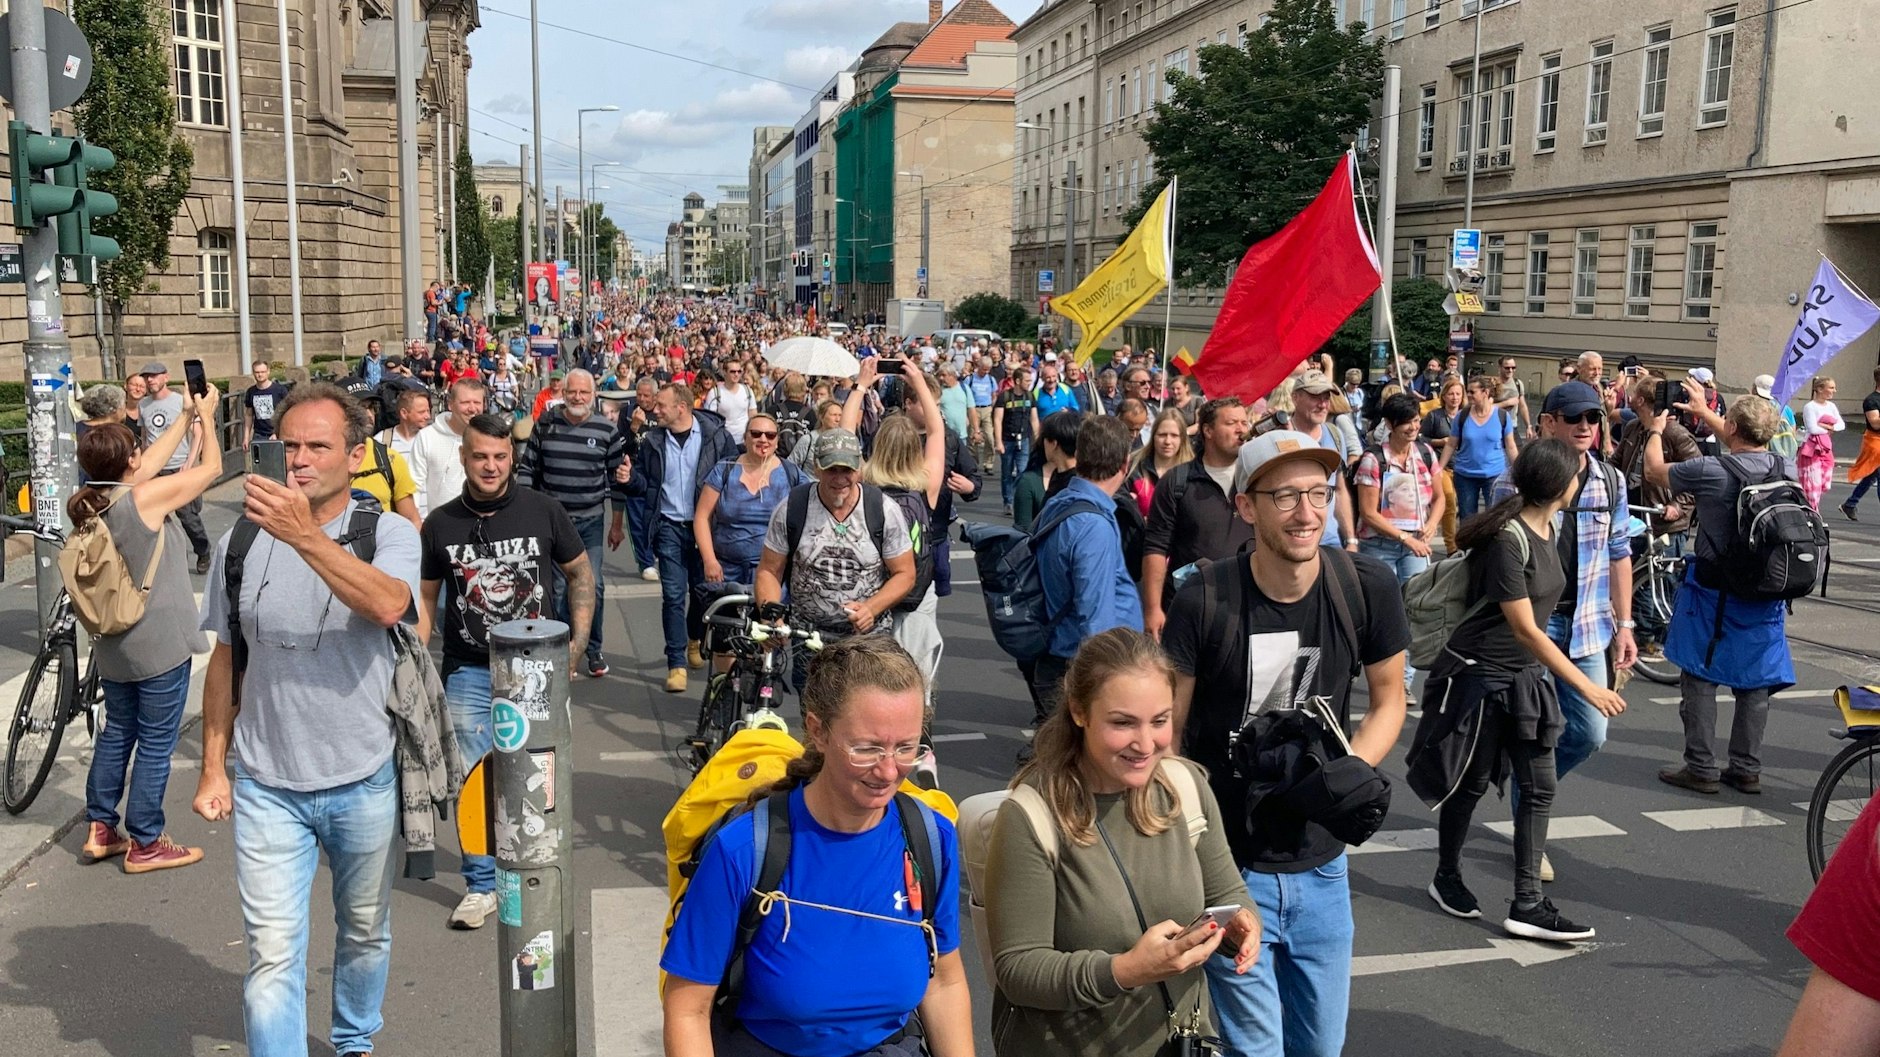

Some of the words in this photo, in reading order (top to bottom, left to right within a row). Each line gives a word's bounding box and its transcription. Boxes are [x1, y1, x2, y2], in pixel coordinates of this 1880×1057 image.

[1458, 294, 1480, 306] Ja!
[38, 499, 58, 511] BNE
[445, 536, 540, 564] YAUZA
